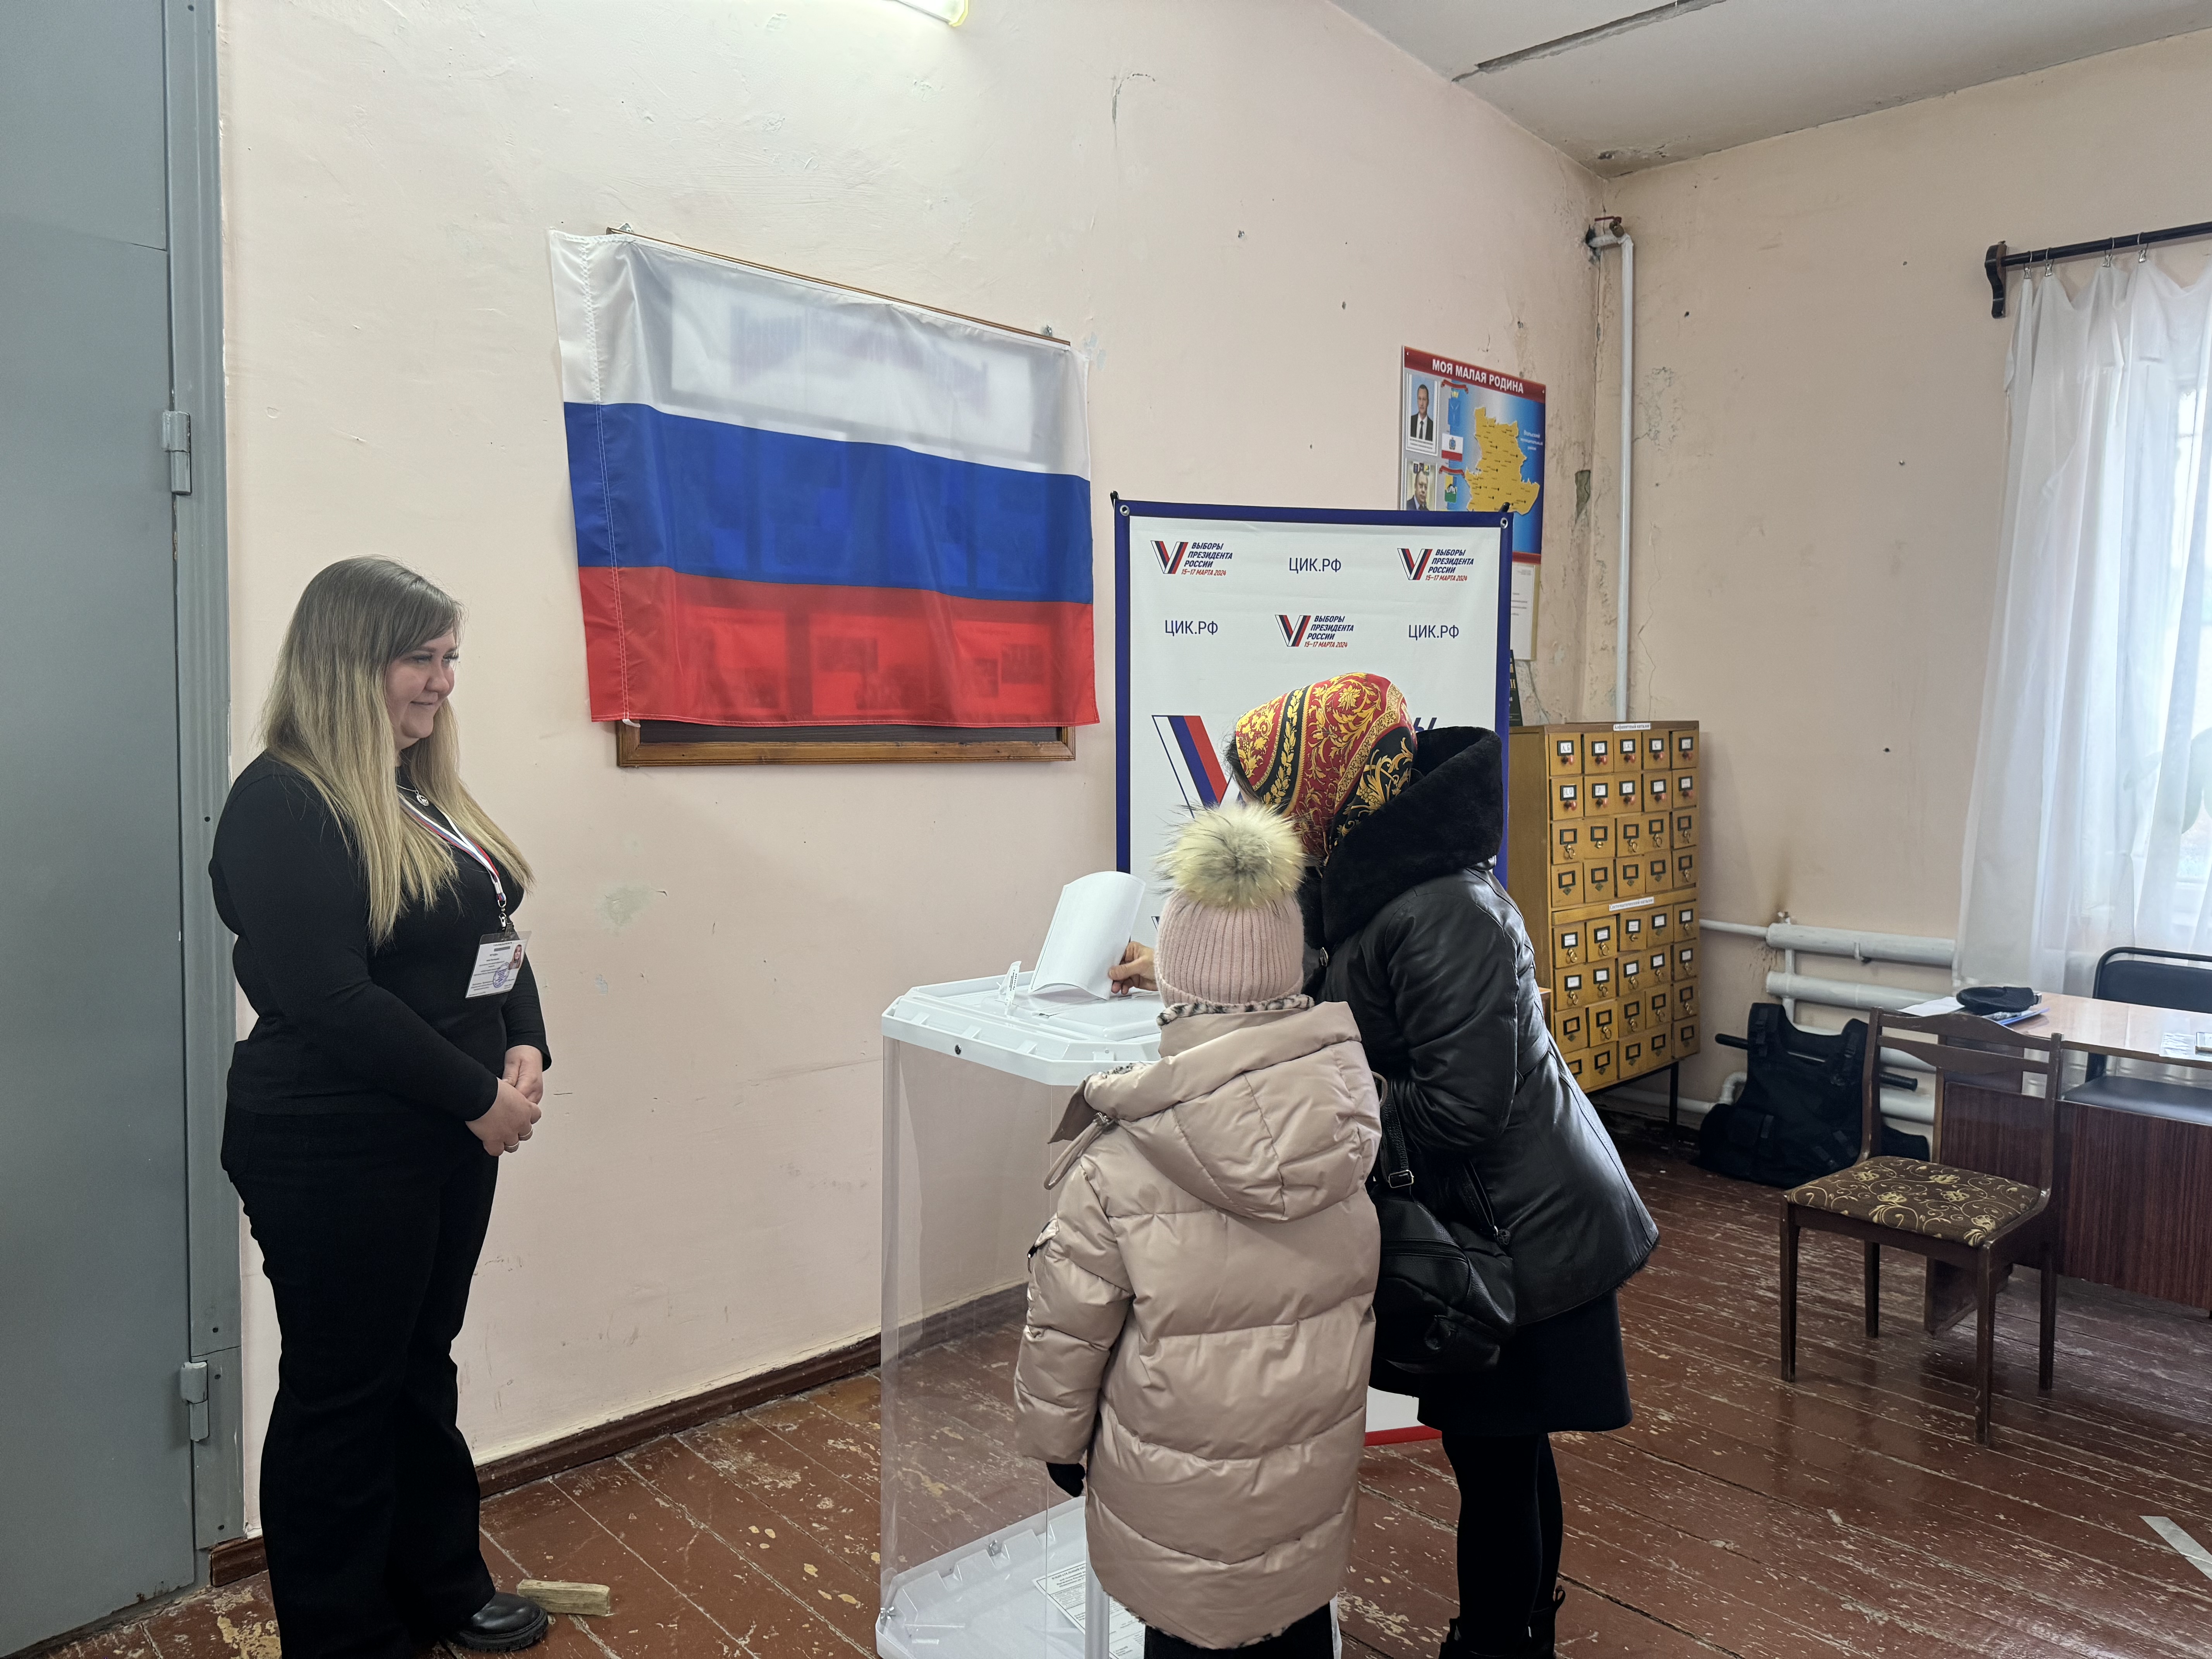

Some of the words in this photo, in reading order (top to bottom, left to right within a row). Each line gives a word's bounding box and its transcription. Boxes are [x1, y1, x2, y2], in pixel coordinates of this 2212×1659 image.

[1432, 359, 1453, 375] МОЯ
[1455, 365, 1487, 384] МАЛАЯ
[1489, 374, 1524, 394] РОДИНА
[1187, 551, 1233, 560] ПРЕЗИДЕНТА
[1289, 558, 1341, 574] ЦИК.РФ
[1165, 620, 1218, 637] ЦИК.РФ
[1409, 625, 1459, 641] ЦИК.РФ
